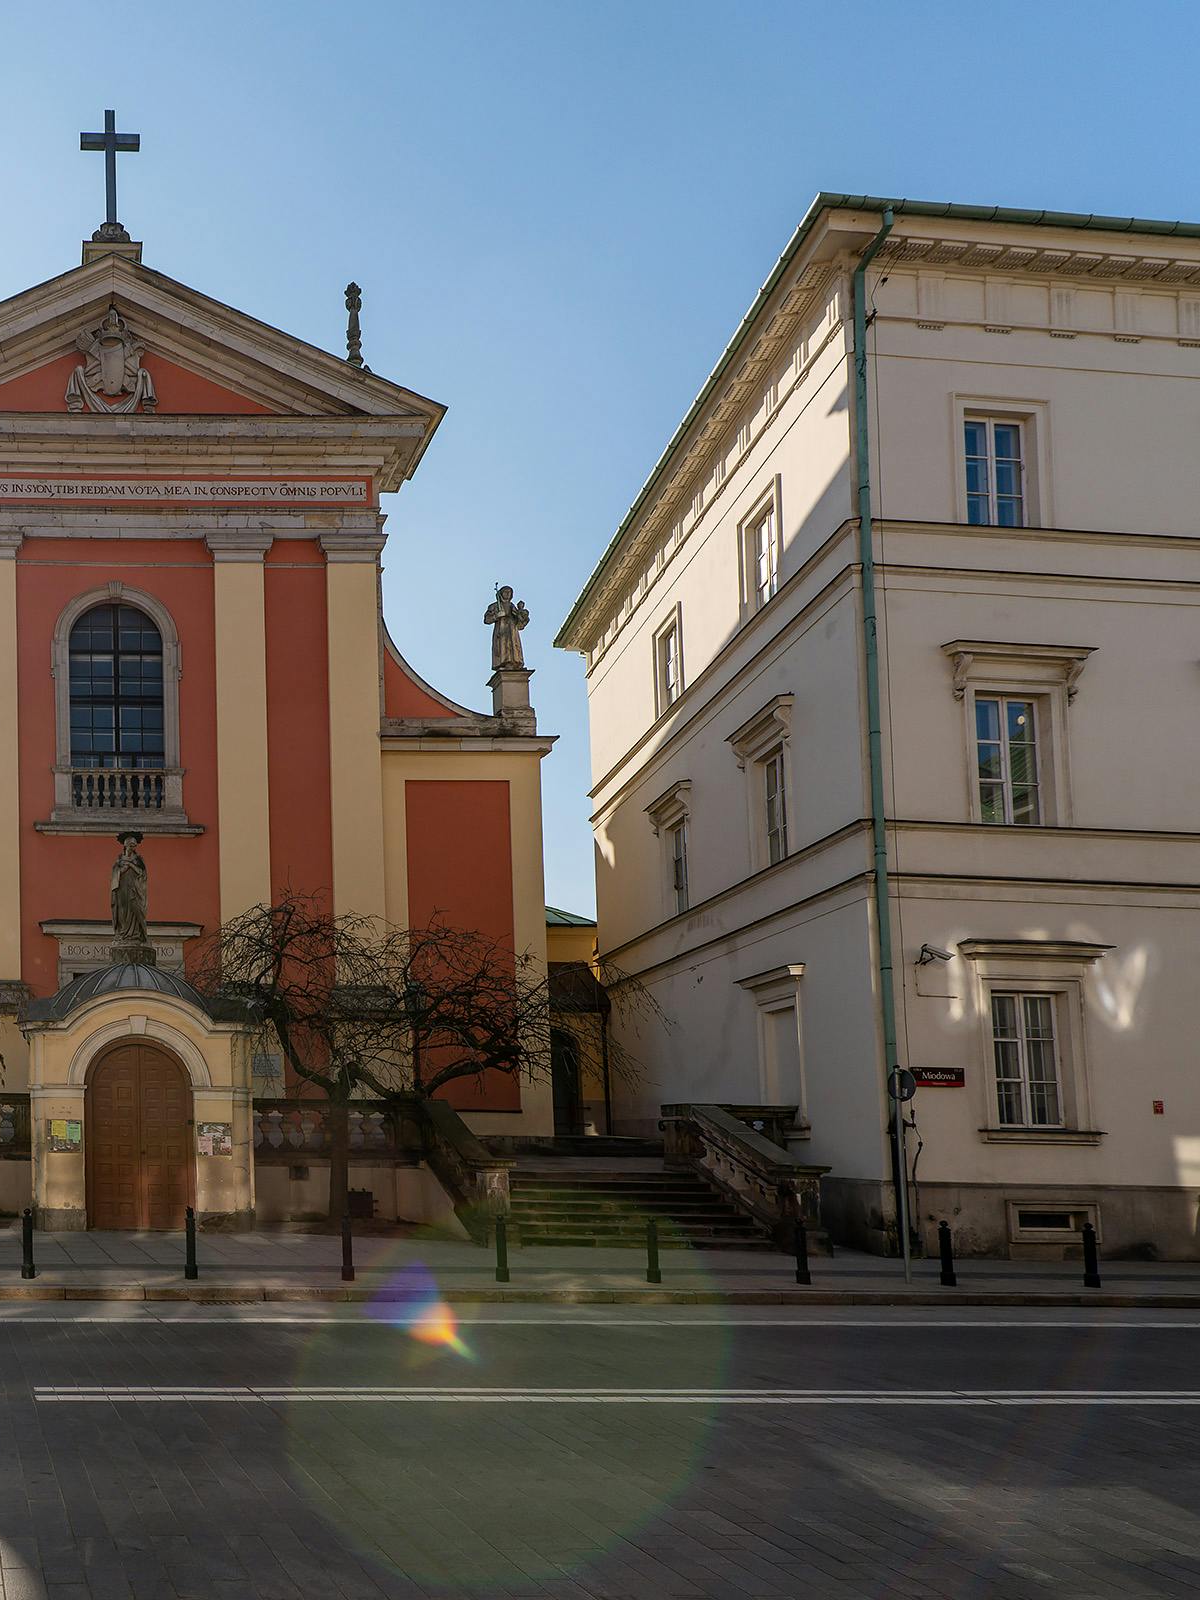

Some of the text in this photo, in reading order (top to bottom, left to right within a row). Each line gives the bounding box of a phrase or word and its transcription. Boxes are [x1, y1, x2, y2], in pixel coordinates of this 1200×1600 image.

[54, 485, 78, 494] TIBI
[81, 485, 125, 495] REDDAM
[127, 486, 161, 495] VOTA
[164, 486, 191, 495] MEA
[922, 1071, 956, 1081] Miodowa
